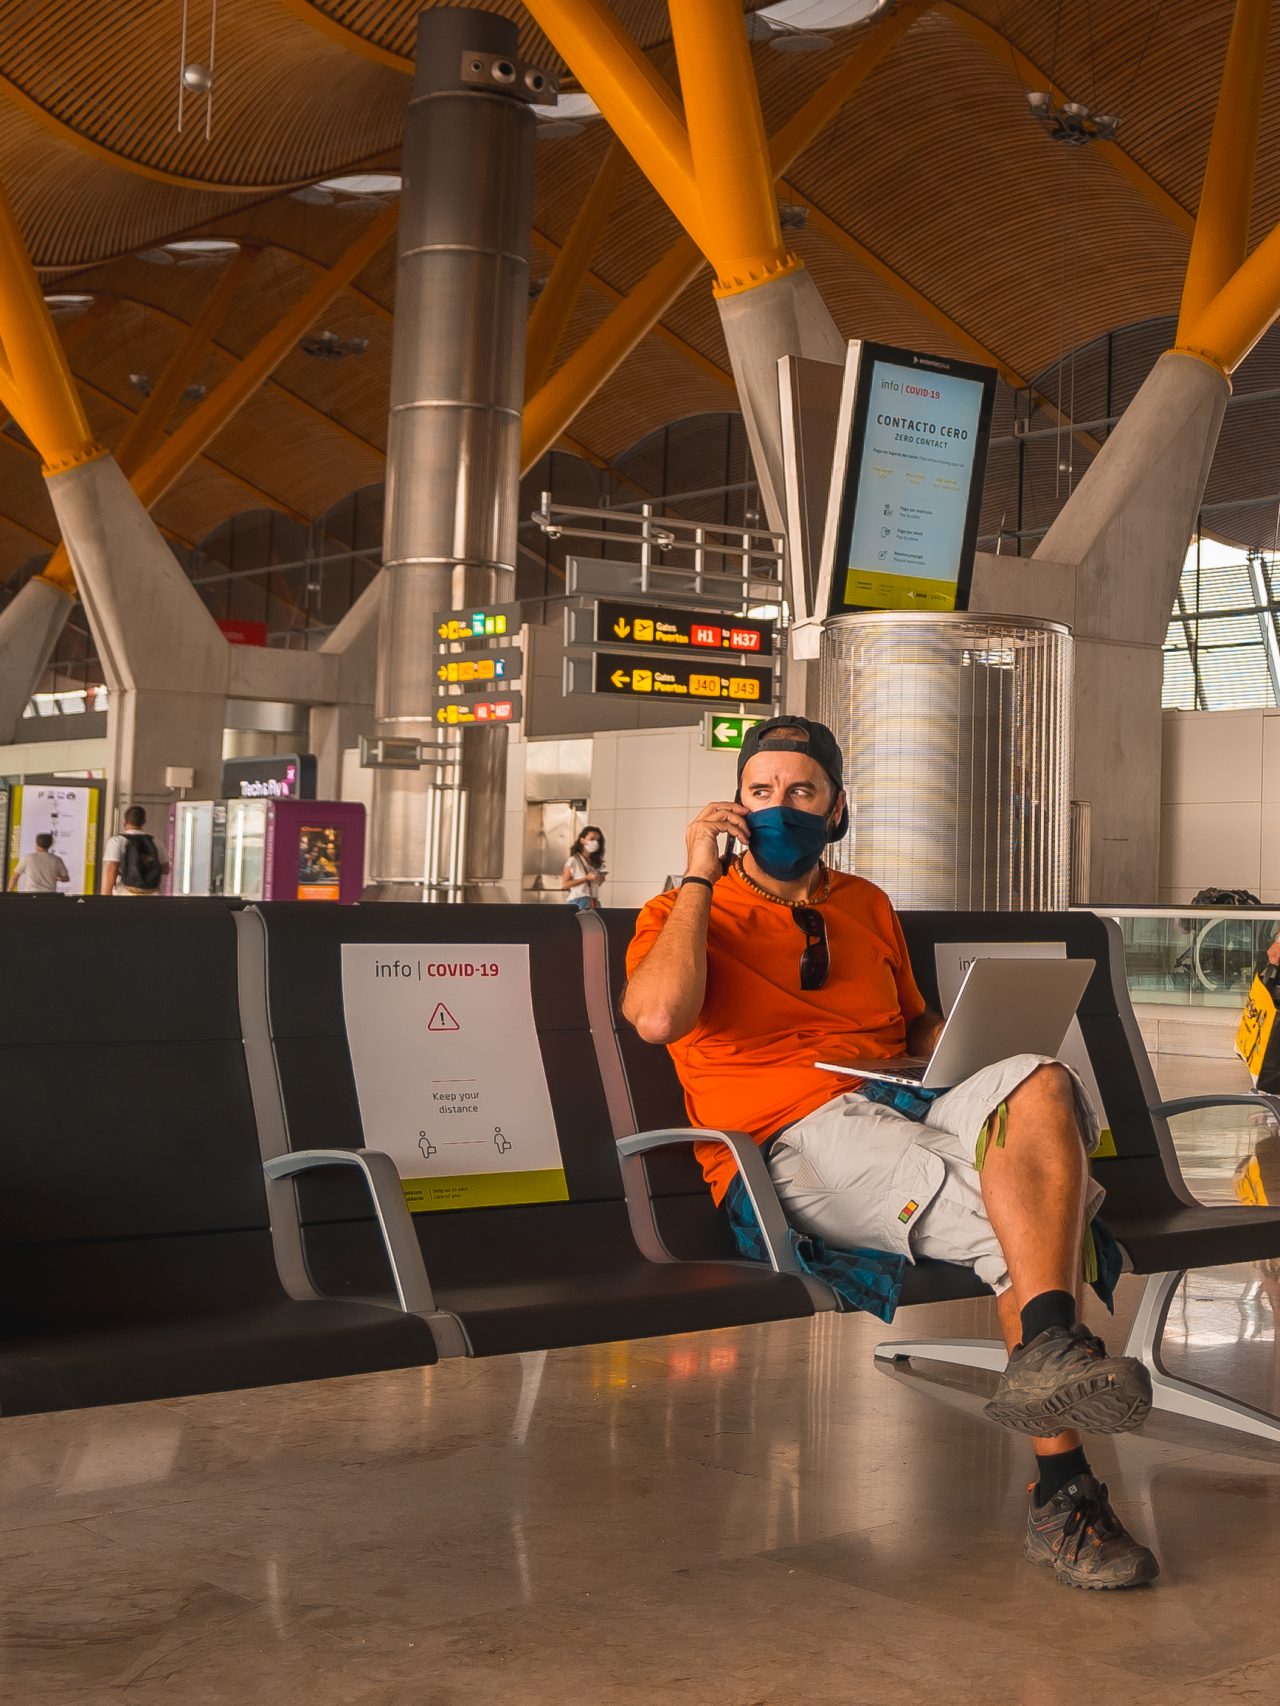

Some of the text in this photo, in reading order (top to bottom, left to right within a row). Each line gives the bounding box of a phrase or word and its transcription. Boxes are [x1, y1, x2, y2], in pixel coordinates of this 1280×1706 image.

[881, 379, 941, 399] info COVID-19
[877, 414, 968, 440] CONTACTO CERO
[894, 433, 948, 449] ZERO CONTACT
[655, 631, 689, 643] Puertas
[697, 629, 757, 647] H1 to H37
[653, 681, 688, 694] Puertas
[694, 678, 756, 695] J40 to J43
[375, 961, 499, 977] info COVID-19
[432, 1091, 480, 1101] Keep your
[439, 1104, 479, 1114] distance
